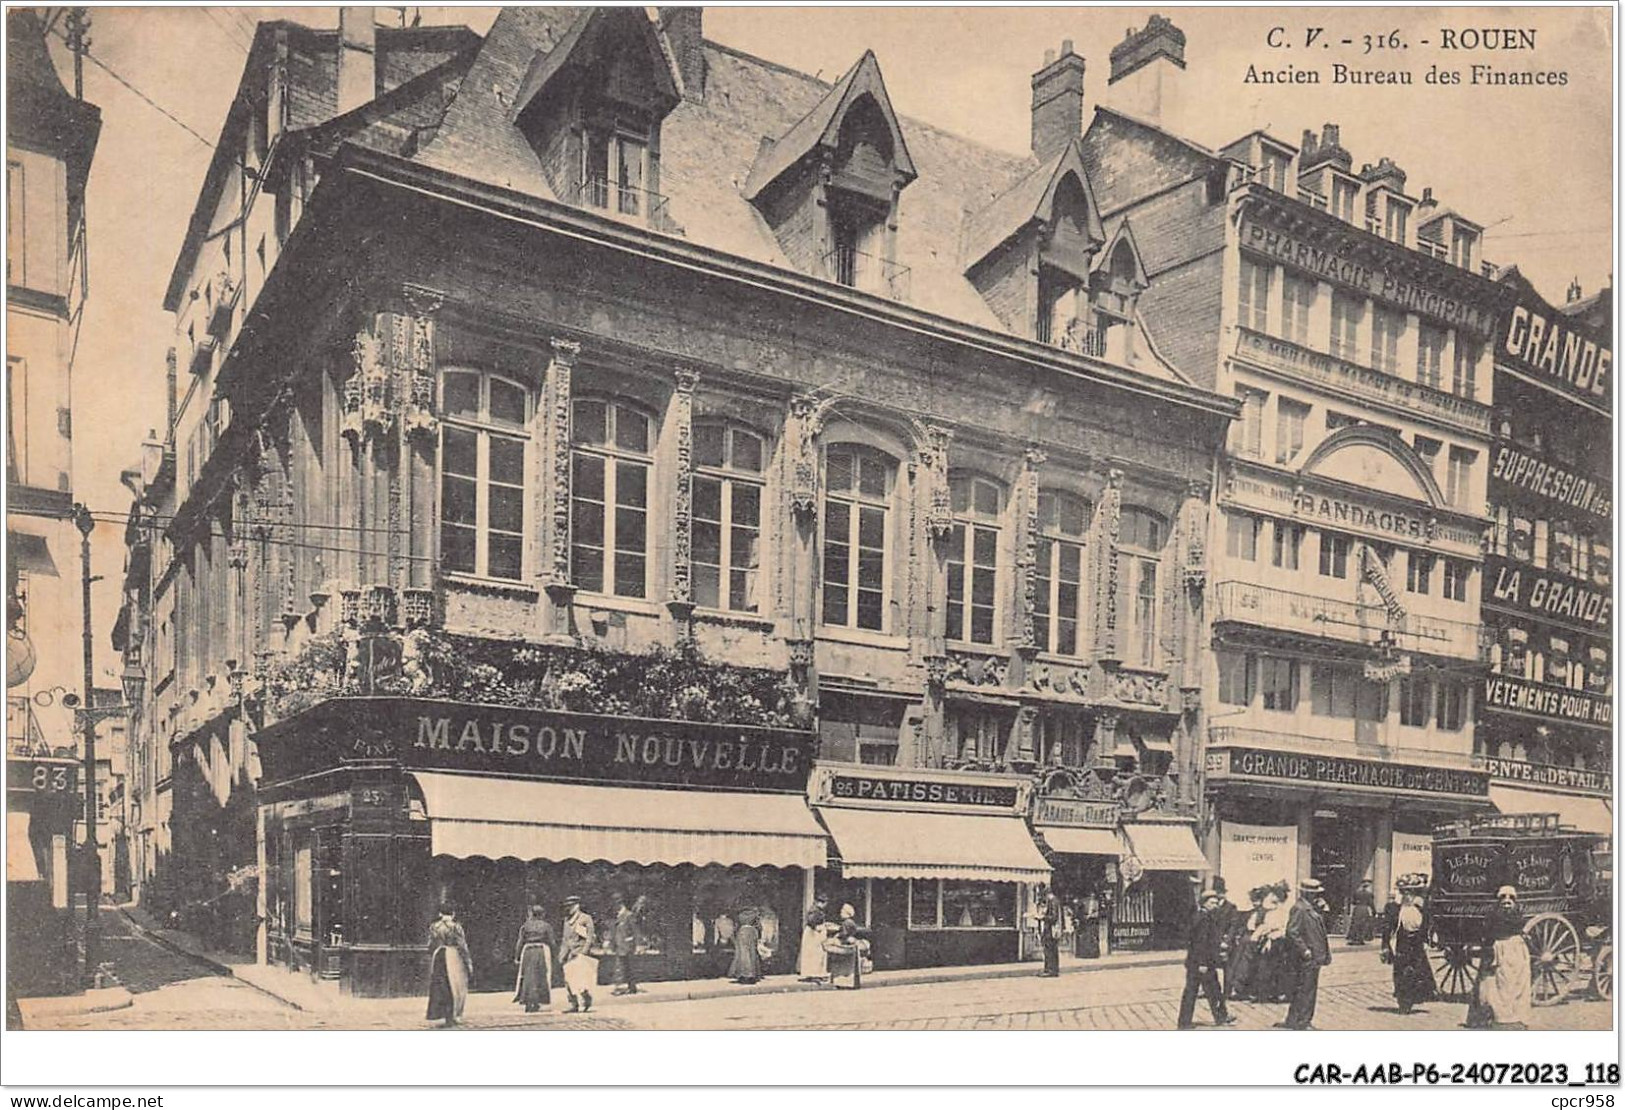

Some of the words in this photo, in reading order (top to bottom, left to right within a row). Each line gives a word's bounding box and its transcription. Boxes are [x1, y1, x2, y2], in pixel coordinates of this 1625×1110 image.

[1250, 226, 1375, 291] PHARMACIE
[1506, 305, 1612, 396] GRANDE
[1493, 447, 1597, 511] SUPPRESSION
[1300, 494, 1420, 538] BANDAGES
[1494, 566, 1521, 603] LA
[1530, 578, 1612, 625] GRANDE
[1559, 694, 1590, 719] POUR
[1593, 700, 1612, 724] HO
[414, 716, 586, 760] MAISON
[615, 733, 799, 775] NOUVELLE
[32, 766, 68, 790] 83
[1242, 753, 1310, 779] GRANDE
[1316, 760, 1404, 787] PHARMACIE
[1533, 772, 1547, 783] au
[836, 782, 853, 796] 25
[858, 781, 996, 805] PATISSERIE
